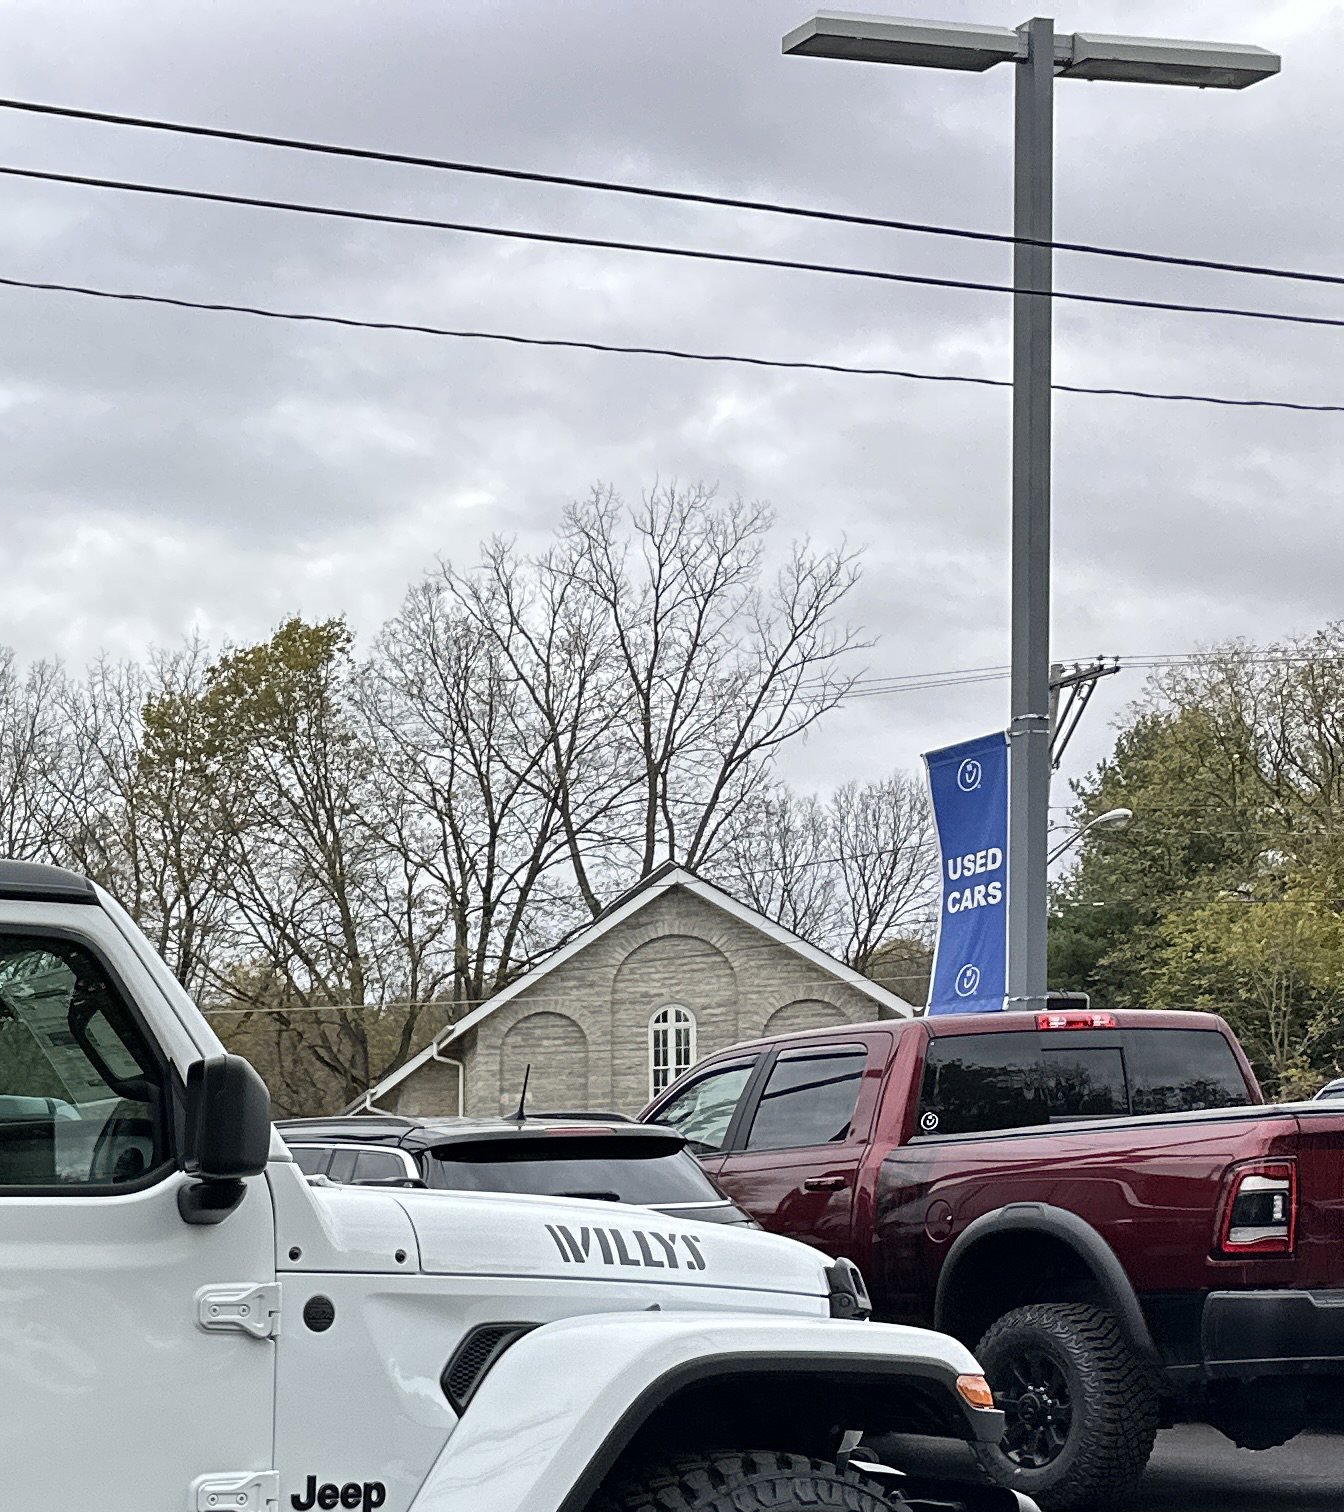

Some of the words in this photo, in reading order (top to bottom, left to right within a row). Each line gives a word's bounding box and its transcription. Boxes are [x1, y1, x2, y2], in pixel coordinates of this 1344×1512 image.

[947, 847, 1003, 880] USED
[946, 881, 1003, 914] CARS
[544, 1223, 707, 1272] WILLYS
